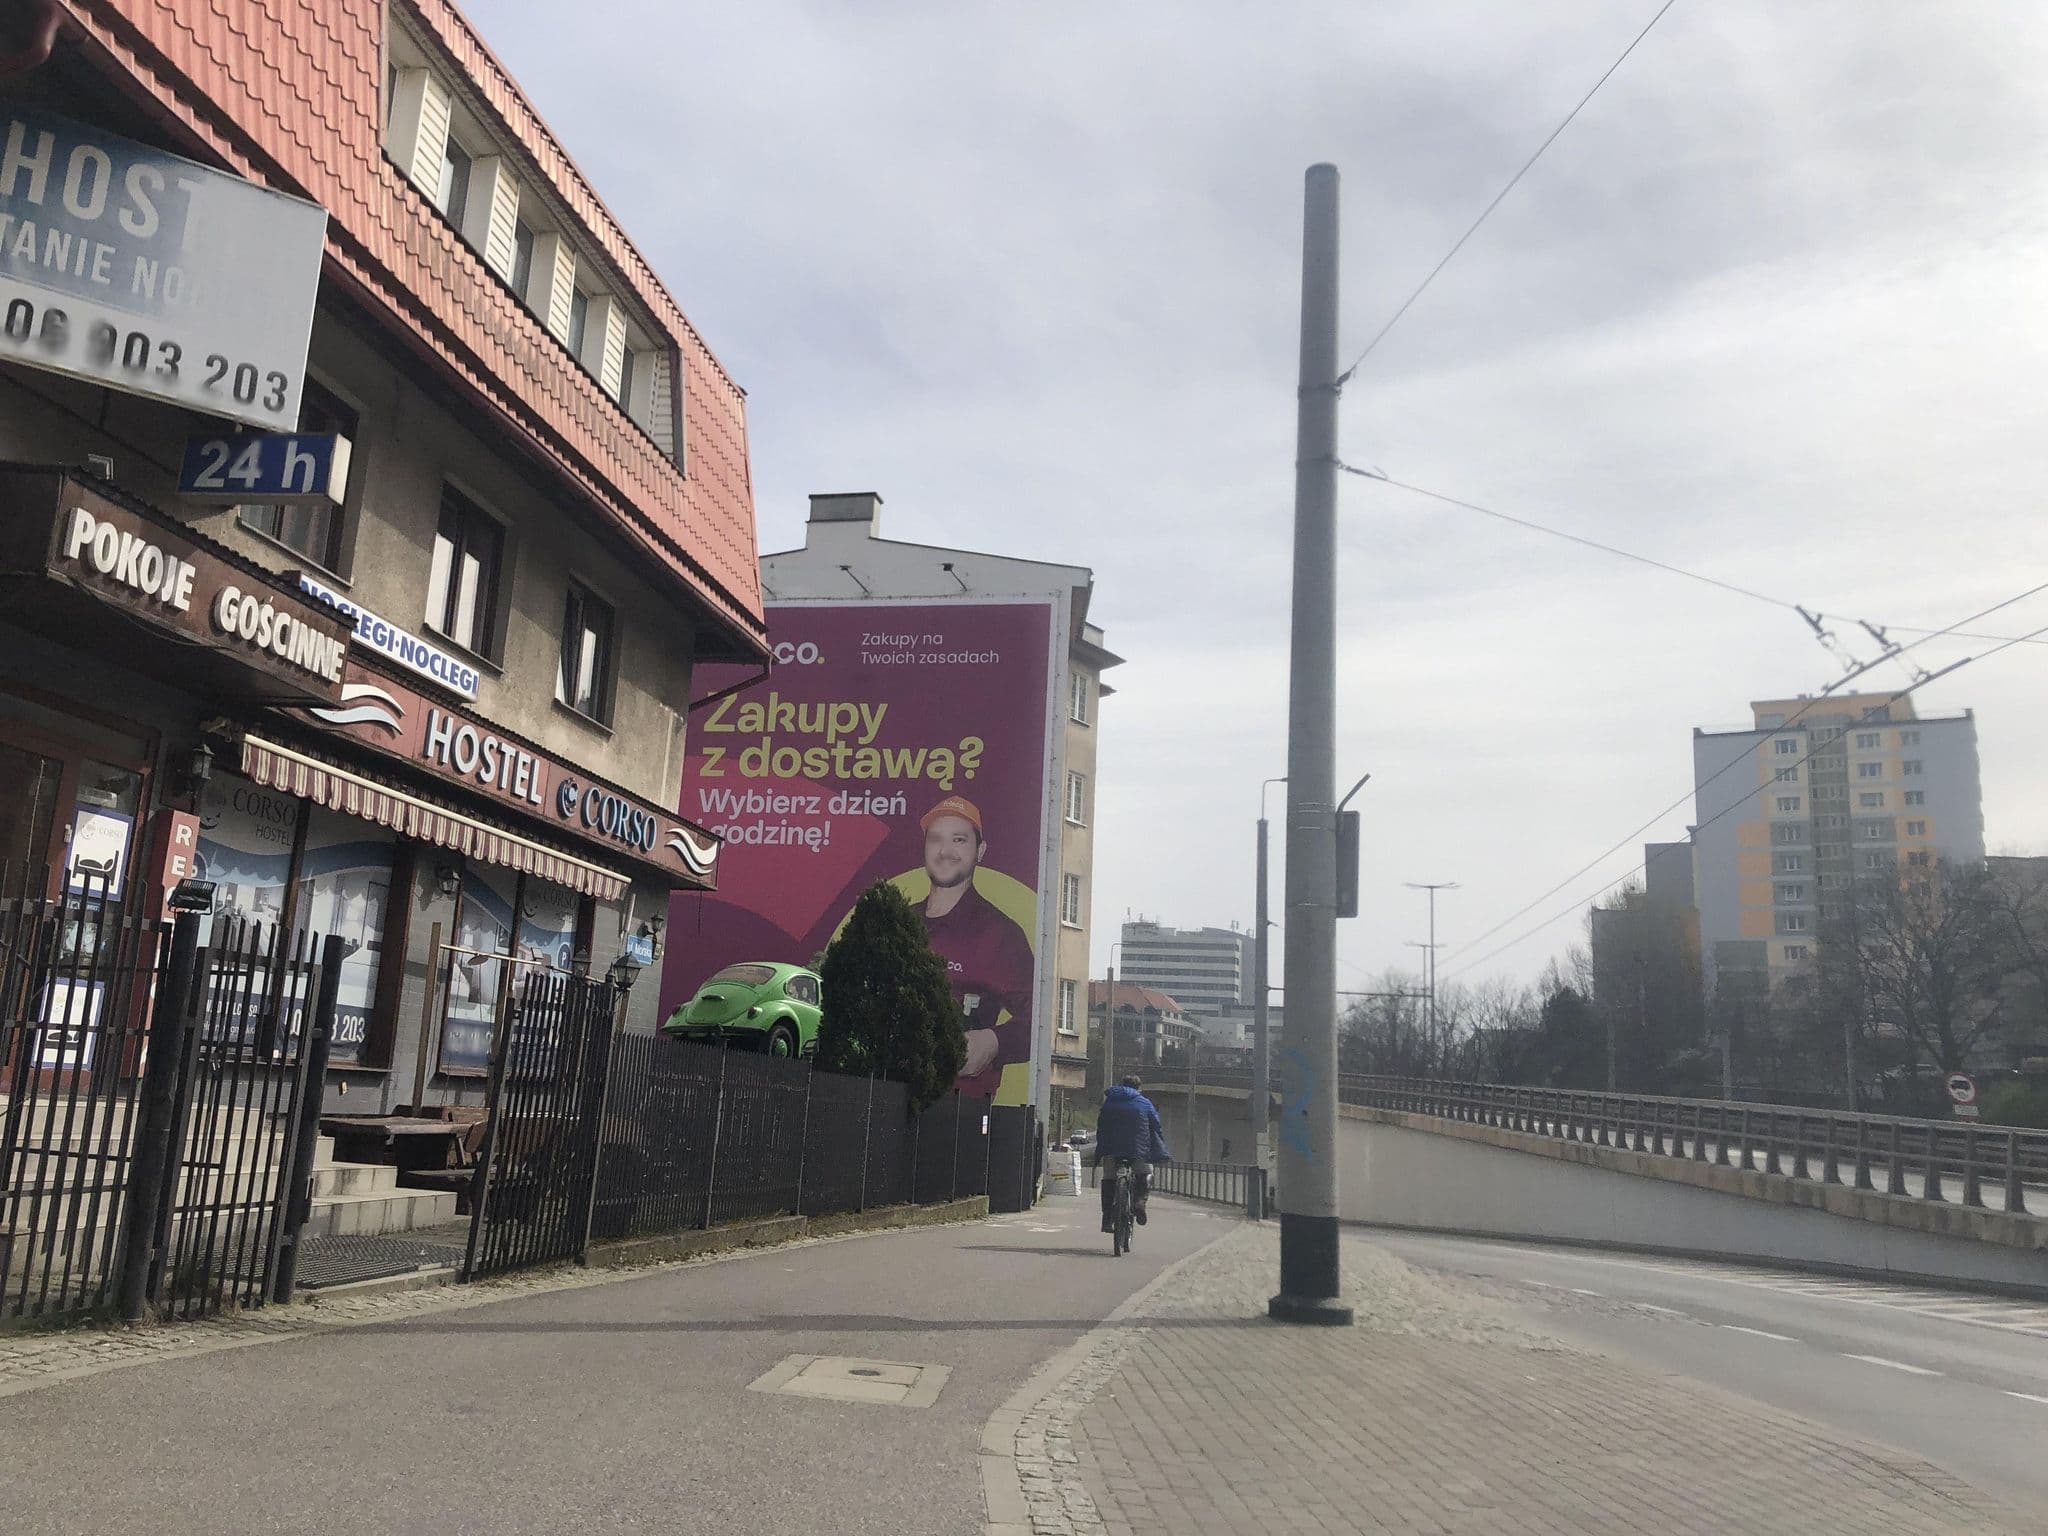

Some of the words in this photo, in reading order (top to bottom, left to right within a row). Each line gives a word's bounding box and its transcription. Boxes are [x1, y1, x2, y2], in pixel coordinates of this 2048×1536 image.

[203, 353, 288, 413] 203
[193, 440, 262, 488] 24
[281, 440, 316, 495] h
[65, 507, 196, 612] POKOJE
[215, 586, 346, 684] GOŚCINNE
[861, 650, 915, 665] Twoich
[919, 649, 1000, 665] zasadach
[862, 631, 918, 649] Zakupy
[922, 635, 943, 646] na
[400, 635, 478, 694] NOCLEGI
[704, 692, 888, 744] Zakupy
[425, 709, 542, 804] HOSTEL
[699, 746, 726, 777] z
[738, 736, 984, 790] dostawą?
[233, 787, 297, 827] CORSO
[584, 786, 657, 852] CORSO
[699, 788, 821, 820] Wybierz
[827, 790, 906, 816] dzień
[340, 1014, 366, 1044] 203
